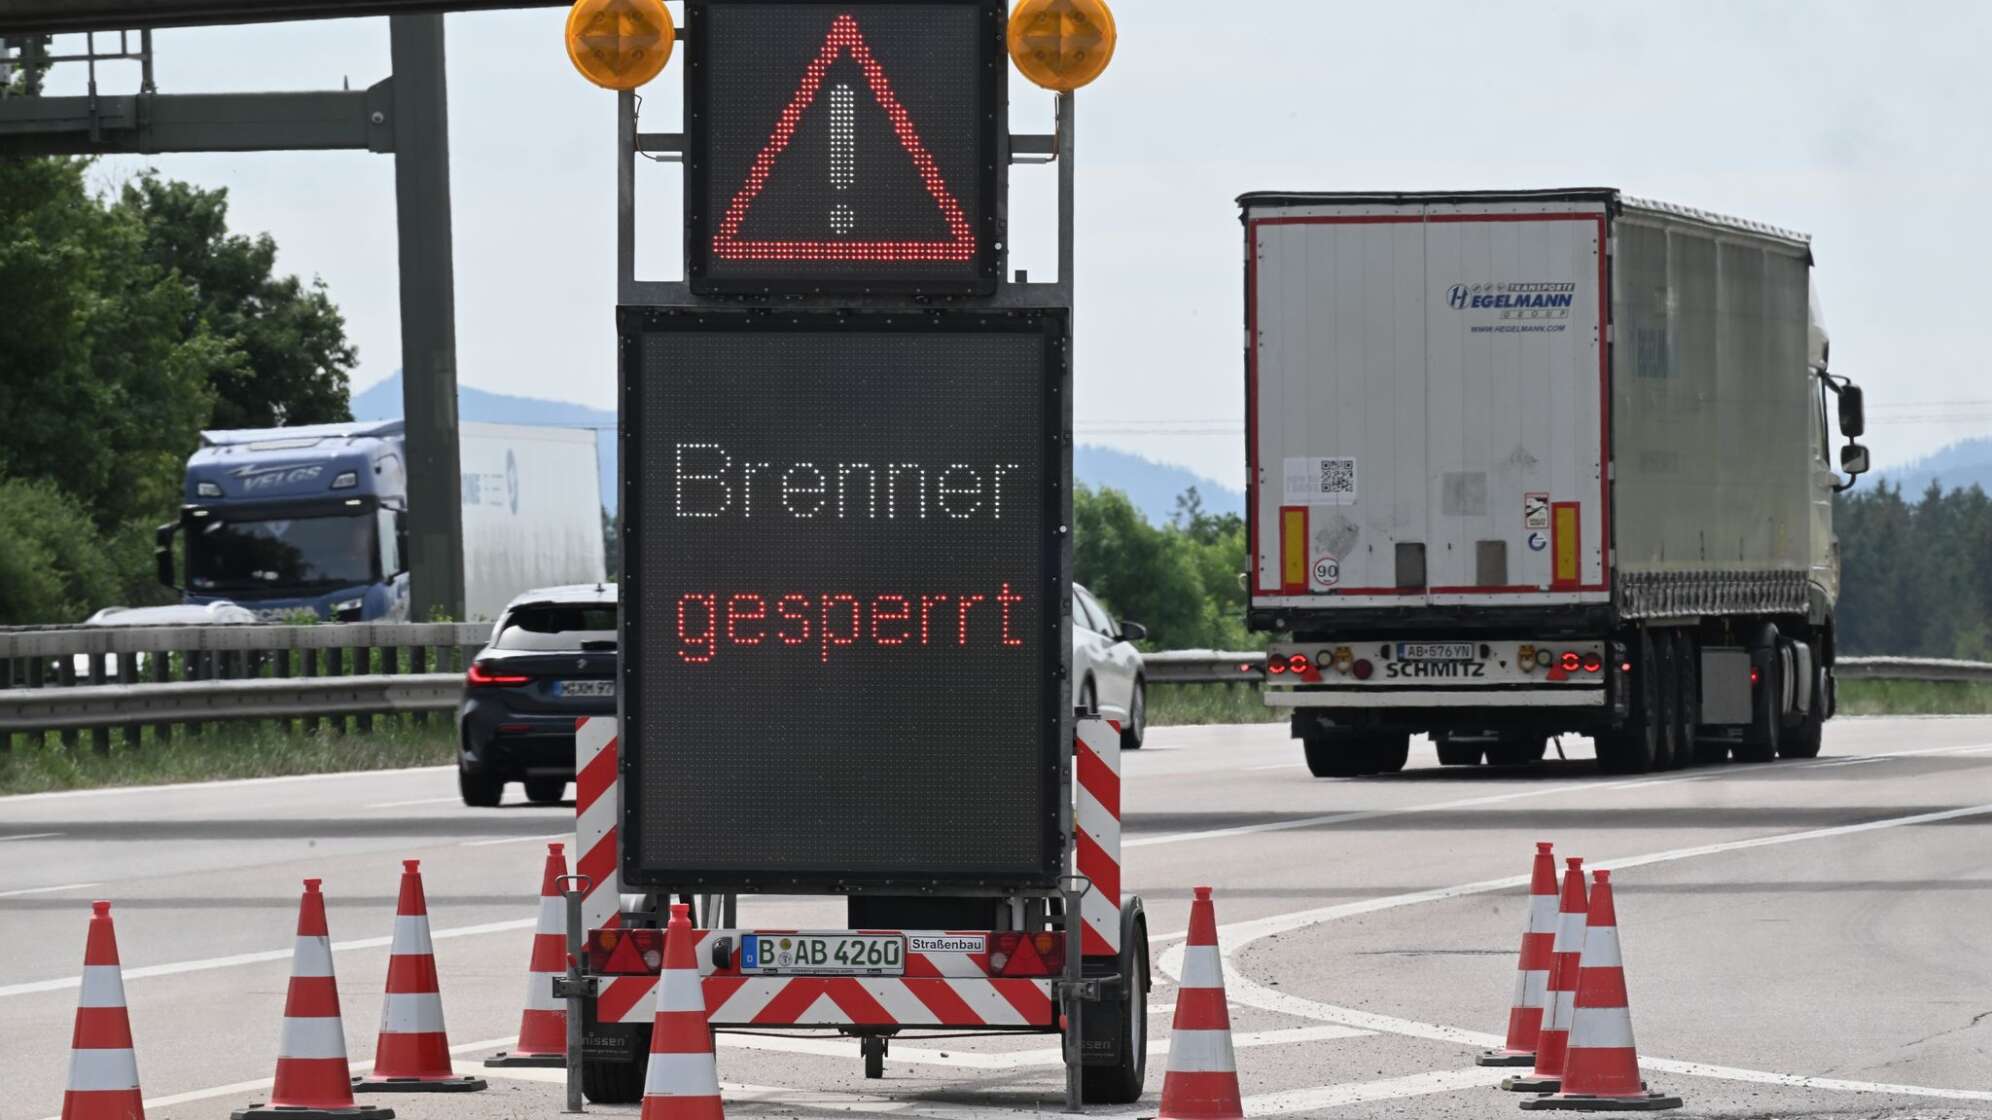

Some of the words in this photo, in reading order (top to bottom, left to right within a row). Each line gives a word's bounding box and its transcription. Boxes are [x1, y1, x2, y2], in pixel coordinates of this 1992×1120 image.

[1449, 285, 1573, 309] HEGELMANN
[676, 443, 1020, 519] Brenner
[1317, 565, 1339, 578] 90
[676, 581, 1025, 664] gesperrt
[1386, 662, 1485, 678] SCHMITZ
[759, 939, 775, 965] B
[795, 939, 828, 965] AB
[834, 939, 900, 965] 4260
[912, 938, 982, 950] Straßenbau
